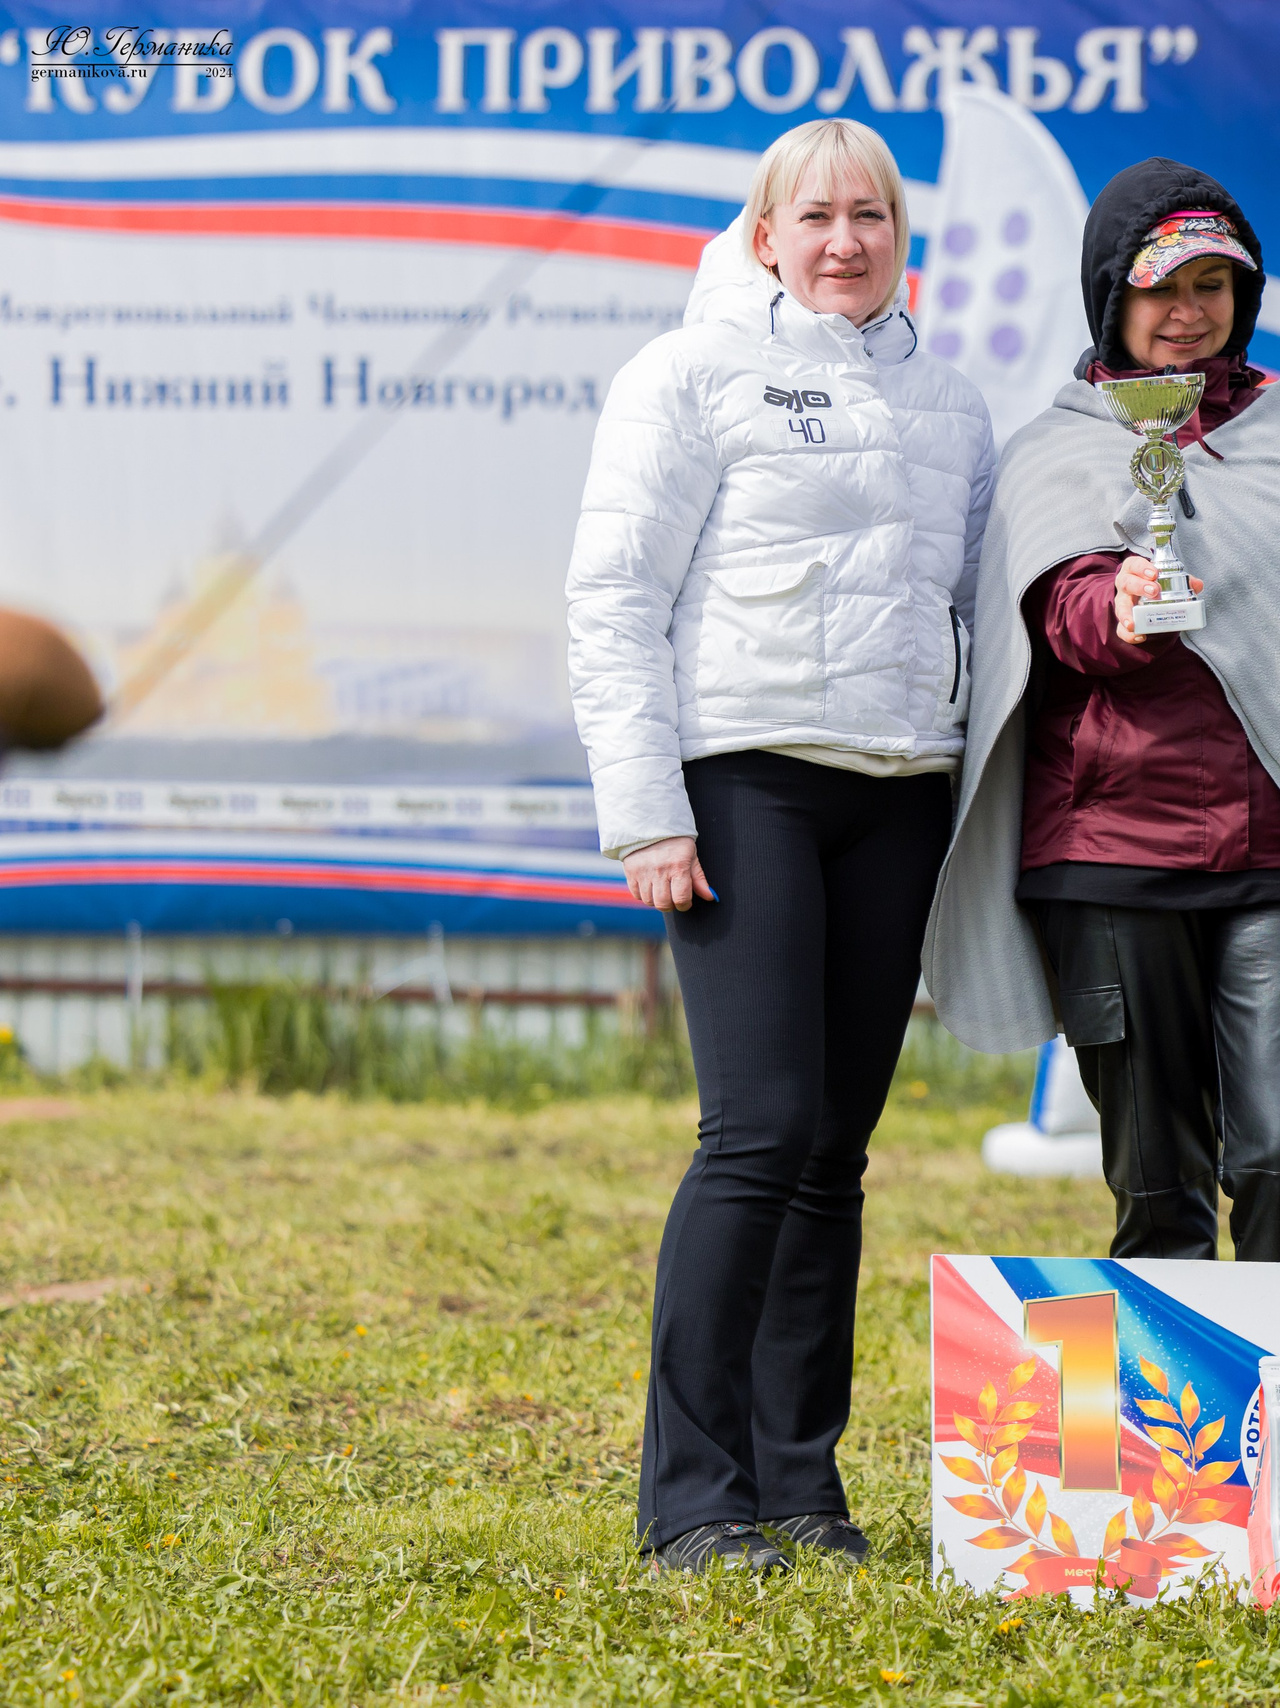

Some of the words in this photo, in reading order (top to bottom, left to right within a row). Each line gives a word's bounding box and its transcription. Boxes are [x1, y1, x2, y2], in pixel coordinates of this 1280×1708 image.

[48, 357, 290, 406] Нижний
[322, 355, 600, 421] Новгород
[788, 417, 826, 444] 40
[1023, 1289, 1122, 1493] 1
